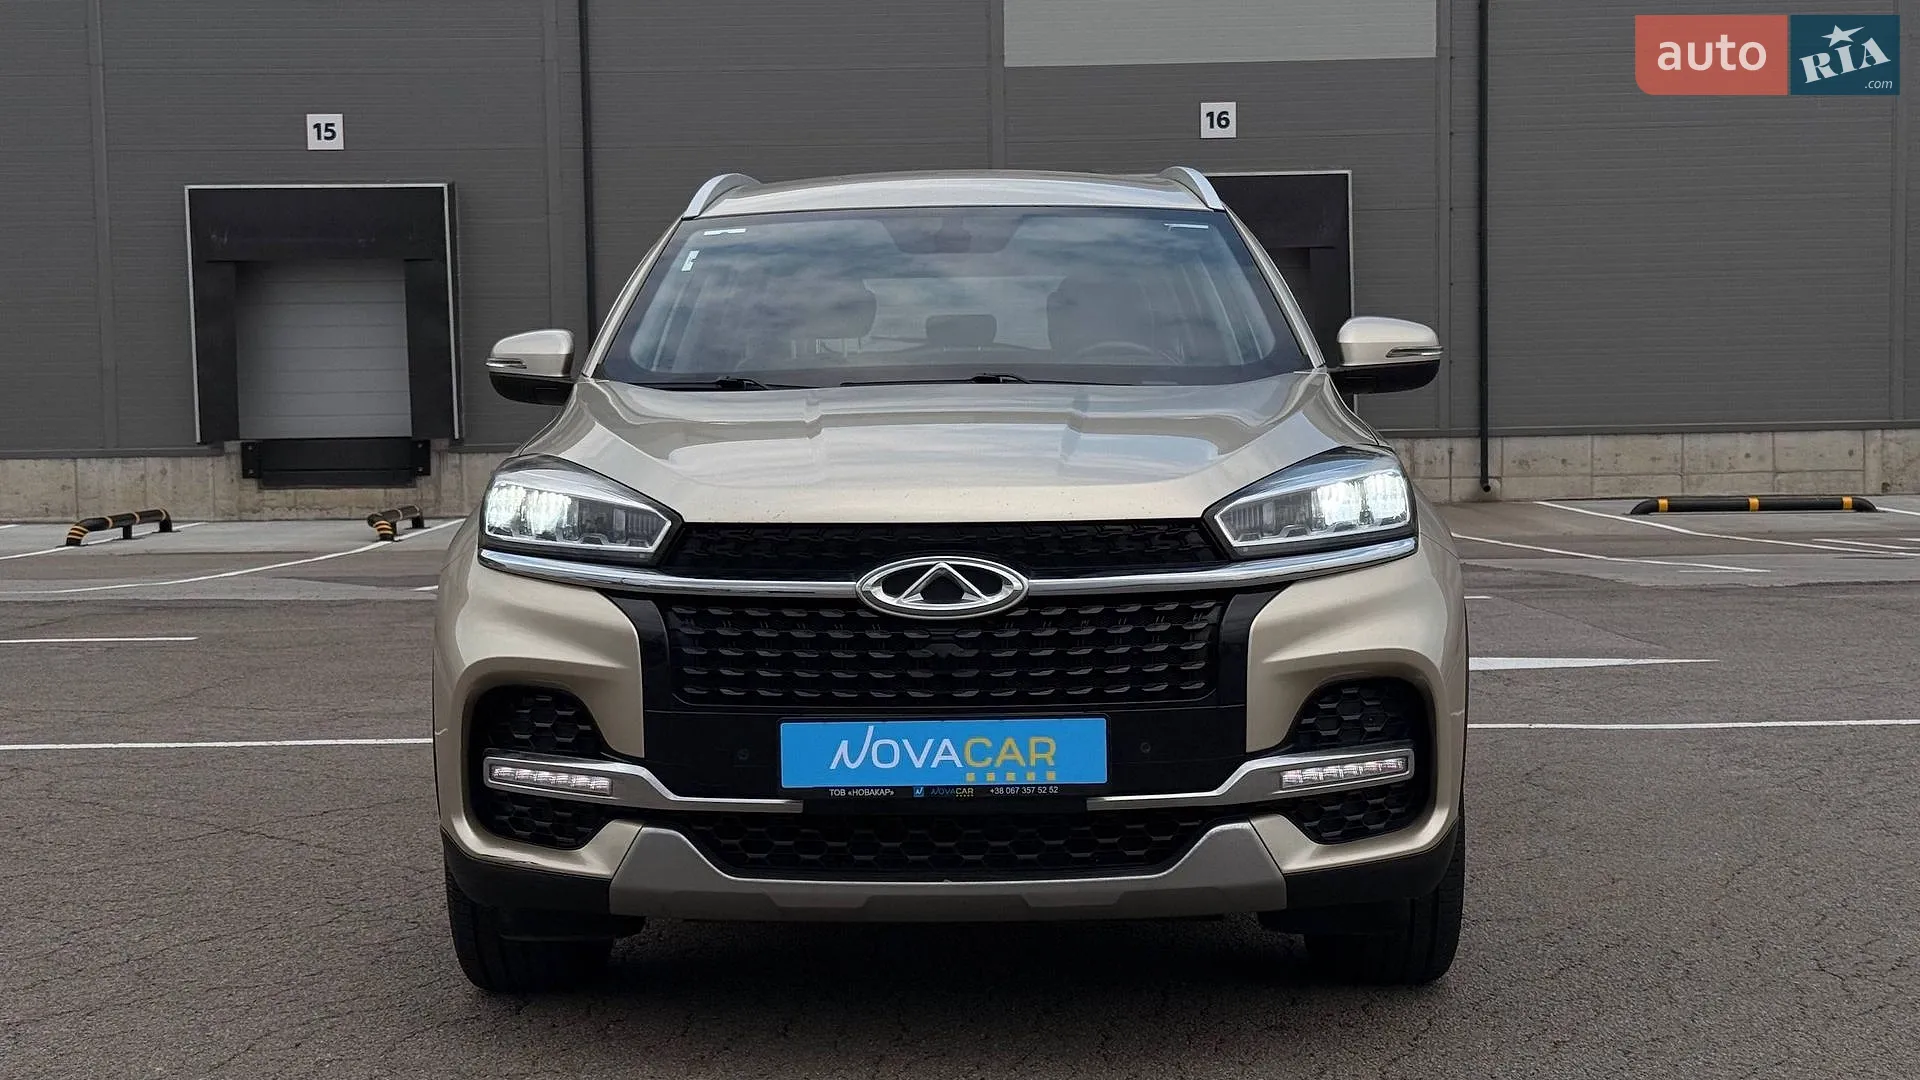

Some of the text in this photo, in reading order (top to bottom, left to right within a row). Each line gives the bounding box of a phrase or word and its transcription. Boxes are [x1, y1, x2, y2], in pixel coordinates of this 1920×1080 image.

[1206, 111, 1230, 129] 16
[313, 122, 337, 141] 15
[829, 788, 894, 796] ТОВ «НОВАКАР»
[990, 786, 1058, 795] +38 067 357 52 52
